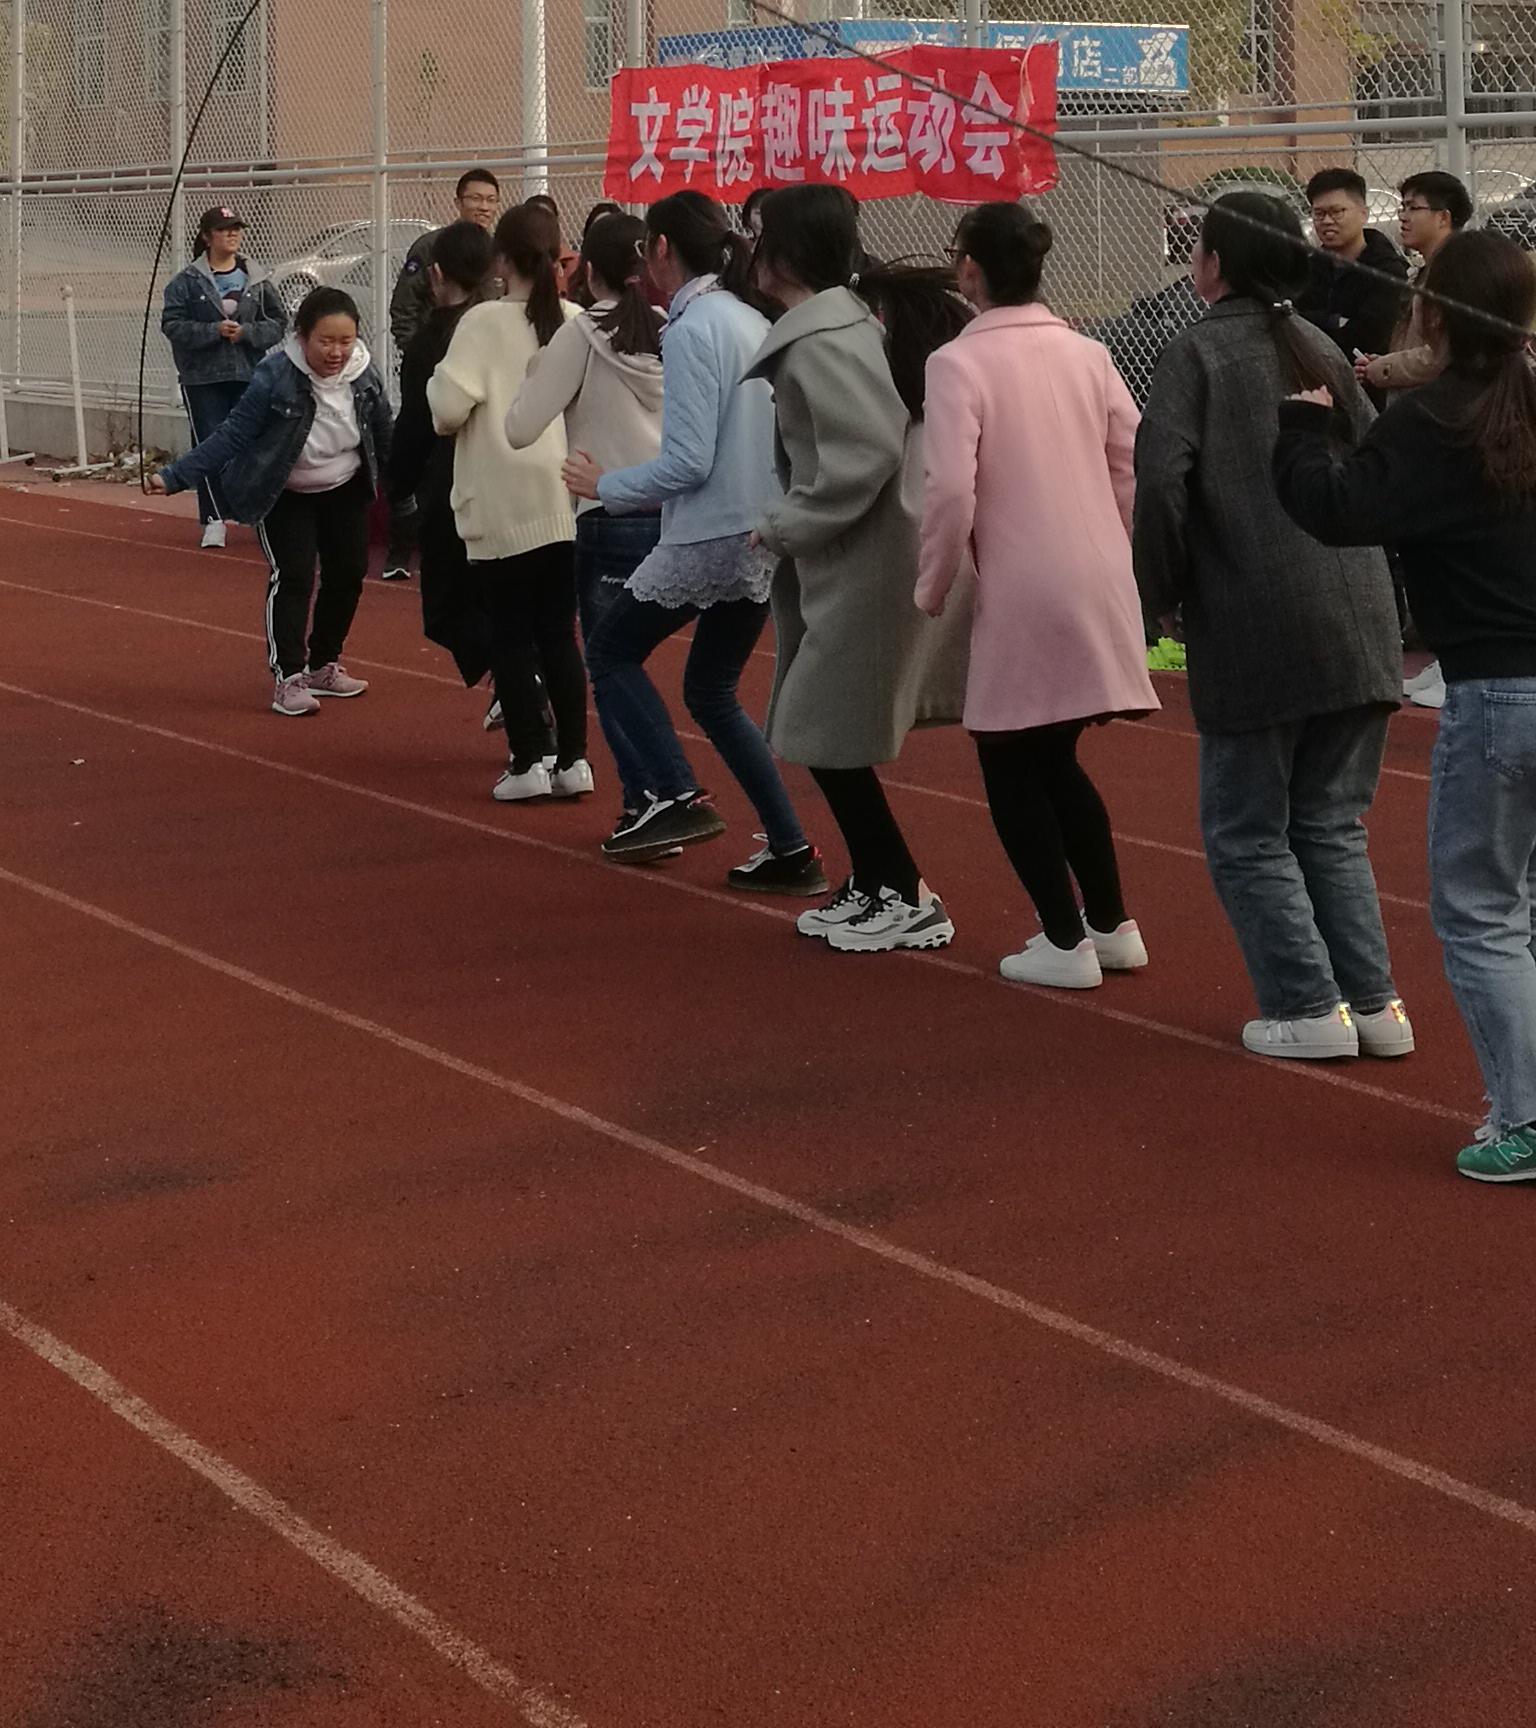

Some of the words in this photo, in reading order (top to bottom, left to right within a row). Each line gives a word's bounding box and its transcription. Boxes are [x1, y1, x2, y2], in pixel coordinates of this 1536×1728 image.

[628, 68, 1014, 187] 文学院趣味运动会
[1496, 1134, 1533, 1165] N
